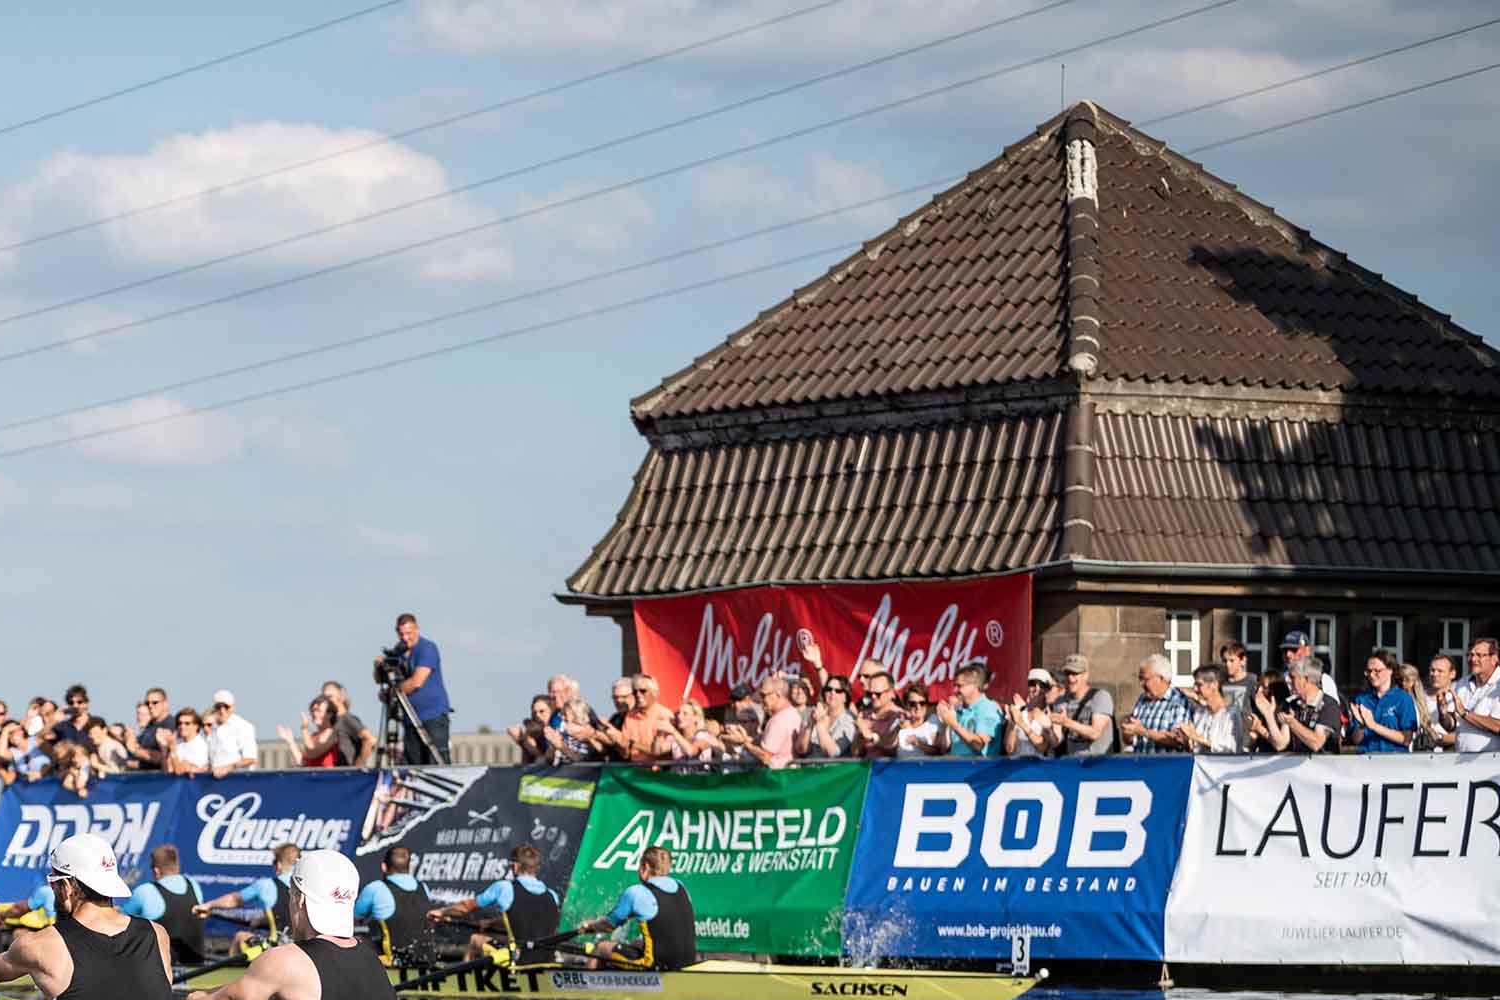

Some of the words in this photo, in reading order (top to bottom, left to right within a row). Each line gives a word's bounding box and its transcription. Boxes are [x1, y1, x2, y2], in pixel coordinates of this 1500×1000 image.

[654, 806, 848, 850] AHNEFELD
[893, 781, 1153, 868] BOB
[1215, 781, 1500, 859] LAUFER
[669, 850, 731, 874] EDITION
[749, 848, 840, 873] WERKSTATT
[887, 877, 966, 892] BAUEN
[982, 877, 1008, 892] IM
[1025, 876, 1138, 892] BESTAND
[1313, 871, 1349, 888] SEIT
[1353, 871, 1388, 888] 1901
[1016, 936, 1025, 962] 3
[563, 971, 588, 985] RBL
[811, 982, 907, 996] SACHSEN
